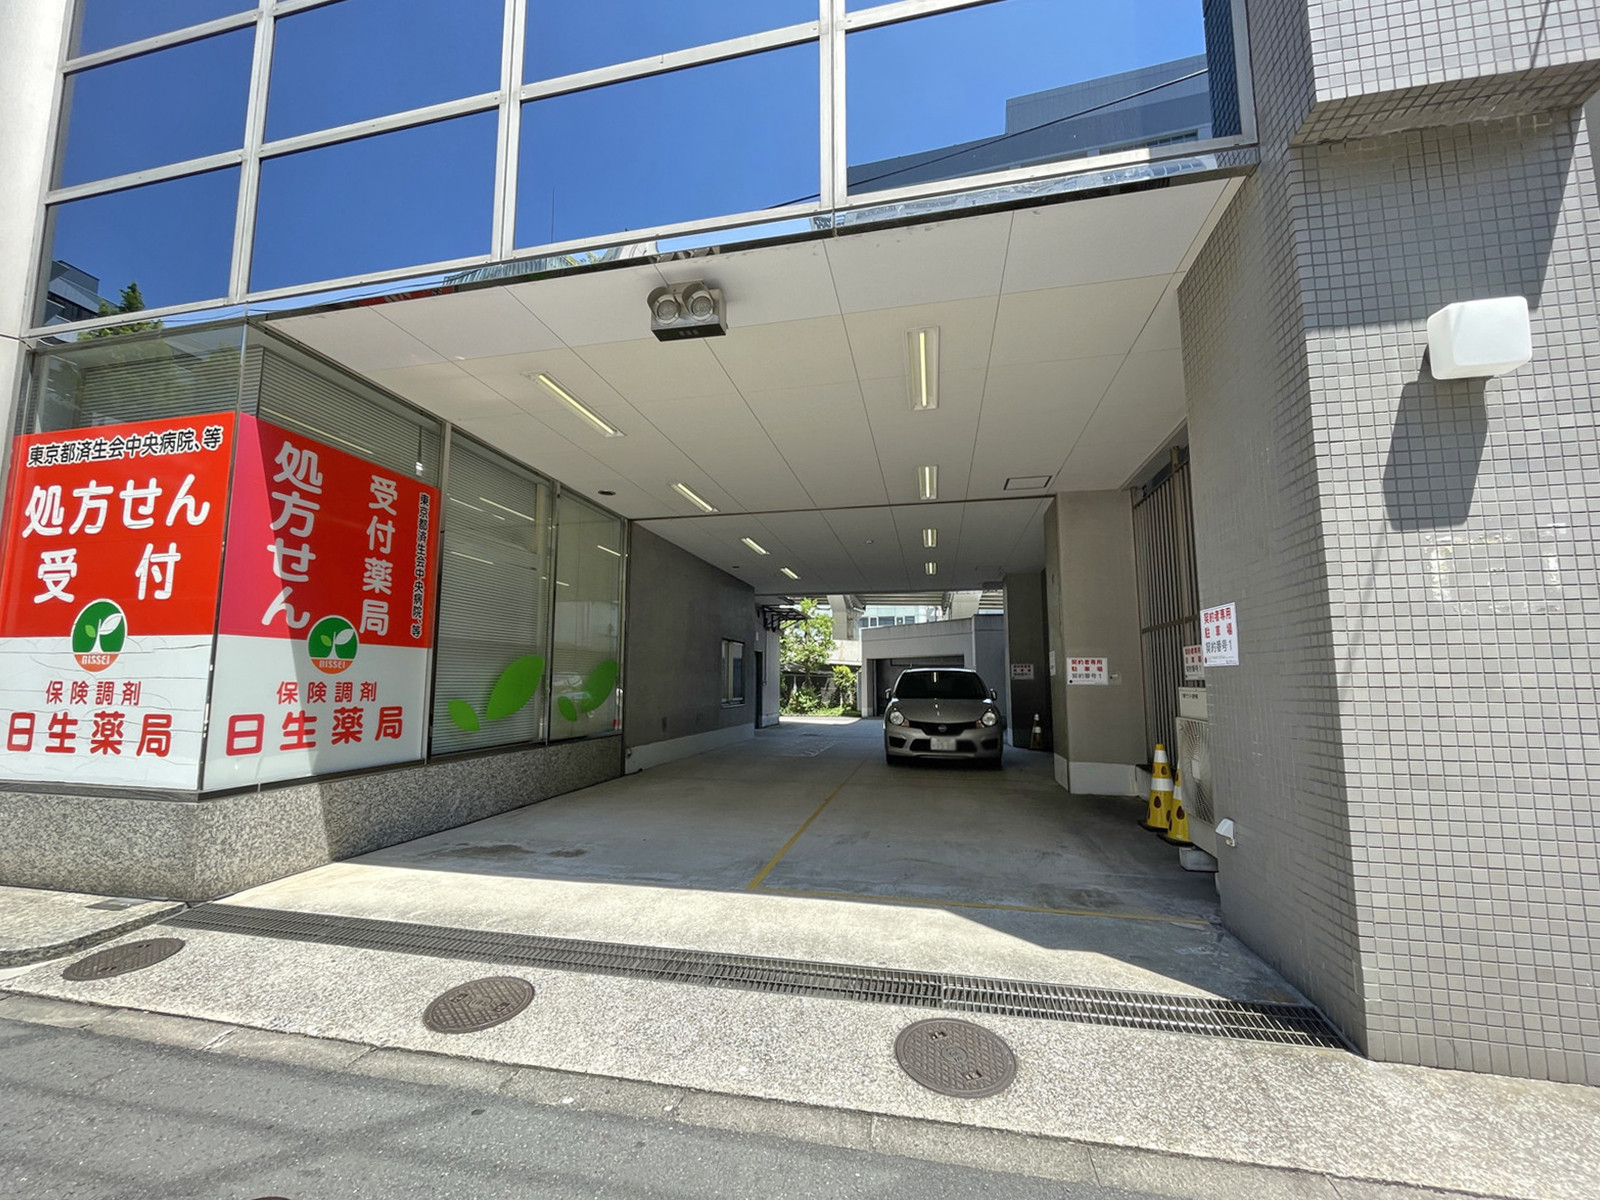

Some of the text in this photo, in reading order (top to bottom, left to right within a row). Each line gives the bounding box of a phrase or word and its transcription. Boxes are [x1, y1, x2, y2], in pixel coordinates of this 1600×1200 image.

[22, 474, 211, 538] 処方せん
[261, 441, 323, 629] 処方せん
[359, 474, 398, 636] 受付薬局
[45, 680, 141, 706] 保険調剤
[276, 681, 377, 705] 保険調剤
[7, 710, 173, 758] 日生薬局
[225, 706, 403, 758] 日生薬局
